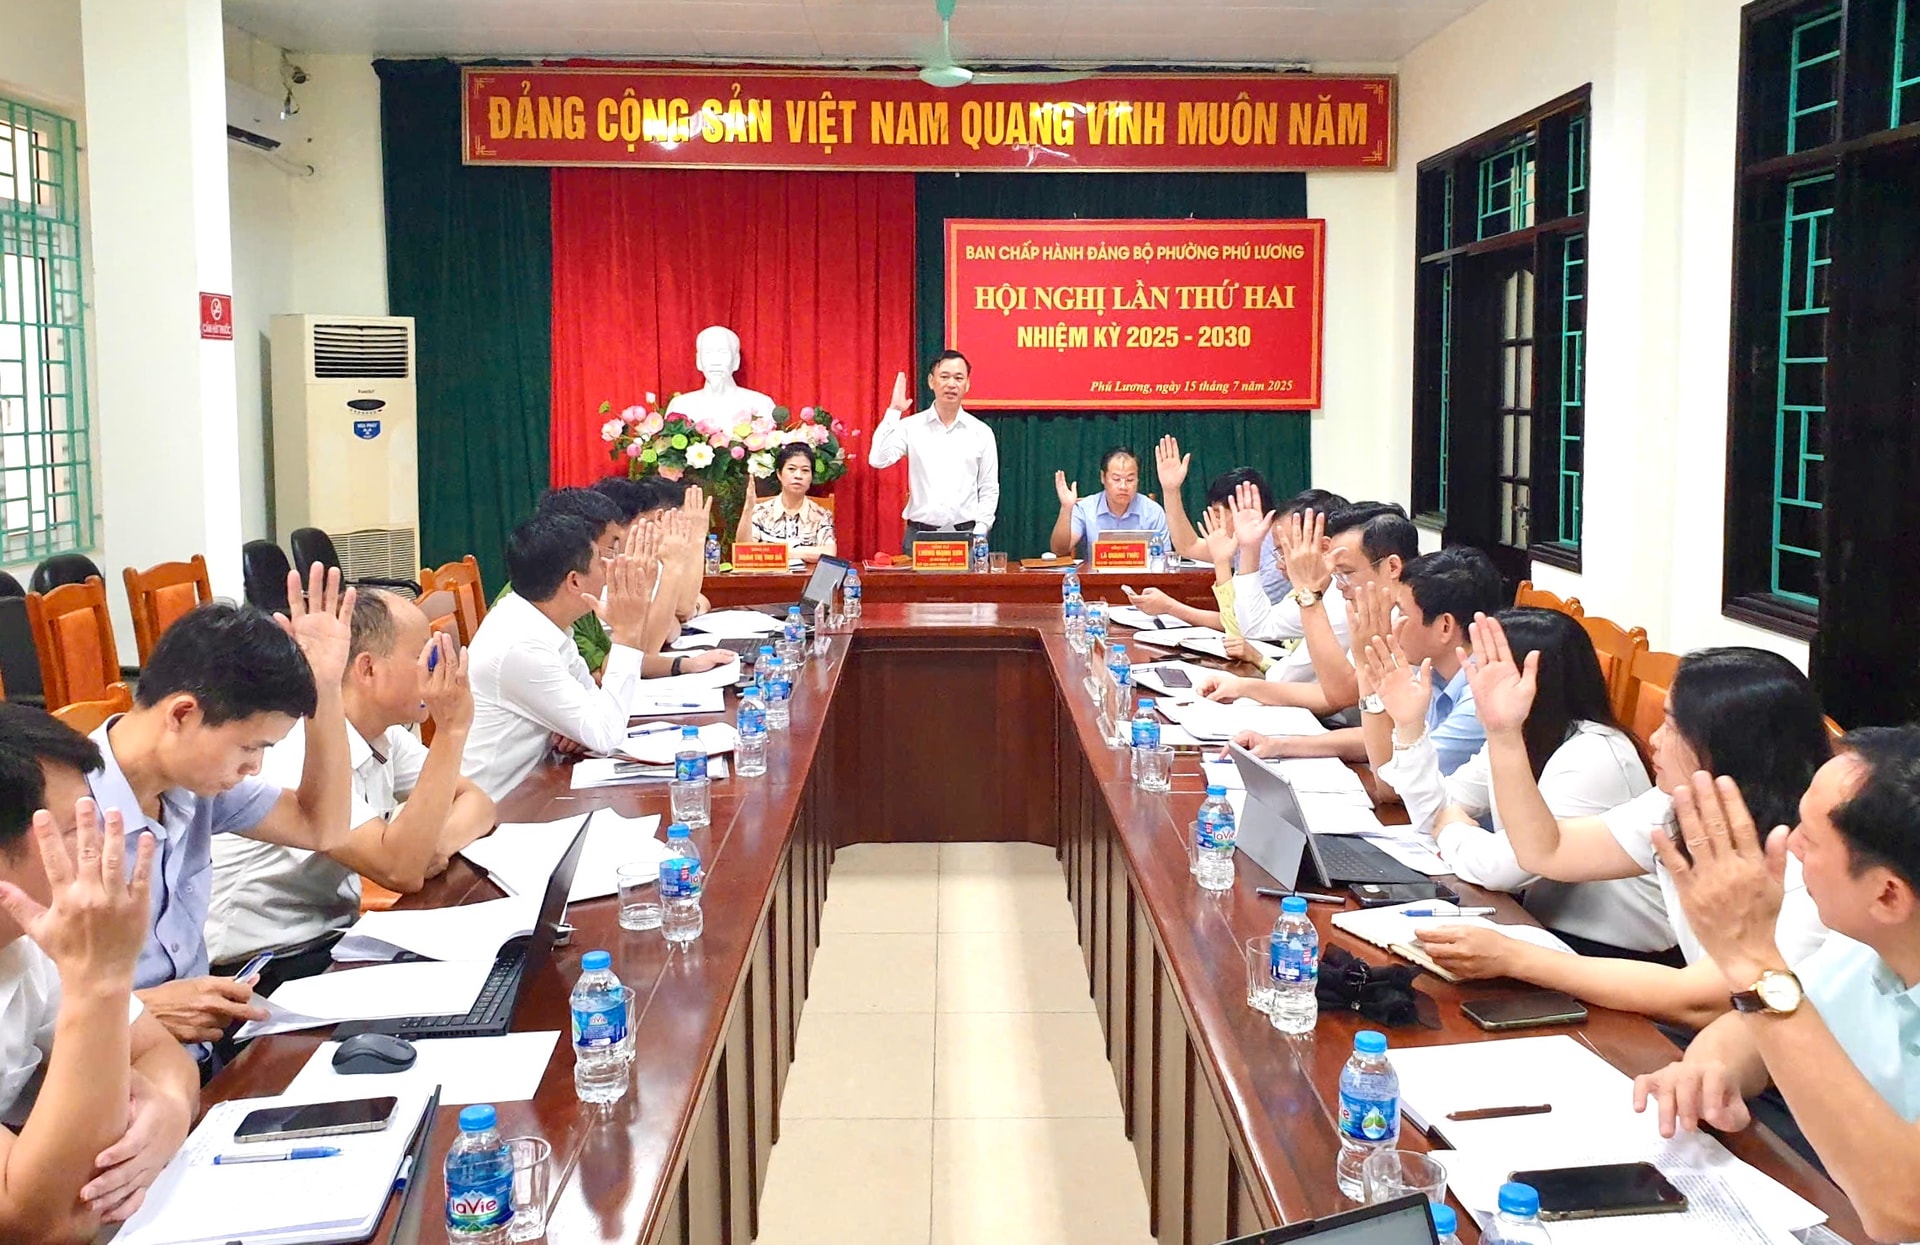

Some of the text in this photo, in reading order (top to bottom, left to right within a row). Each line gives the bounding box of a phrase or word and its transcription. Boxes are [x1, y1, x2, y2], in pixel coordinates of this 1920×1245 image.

[489, 80, 1368, 154] ĐẢNG CỘNG SẢN VIỆT NAM QUANG VINH MUÔN NĂM
[965, 240, 1305, 264] BAN CHẤP HÀNH ĐẢNG BỘ PHƯỜNG PHÚ LƯƠNG
[974, 279, 1296, 316] HỘI NGHỊ LẦN THỨ HAI
[1017, 322, 1088, 352] NHIỆM
[1094, 322, 1121, 347] KỲ
[1126, 326, 1179, 348] 2025
[1198, 325, 1251, 347] 2030
[1090, 380, 1293, 394] Phú Lương, ngày 15 tháng 7 năm 2025
